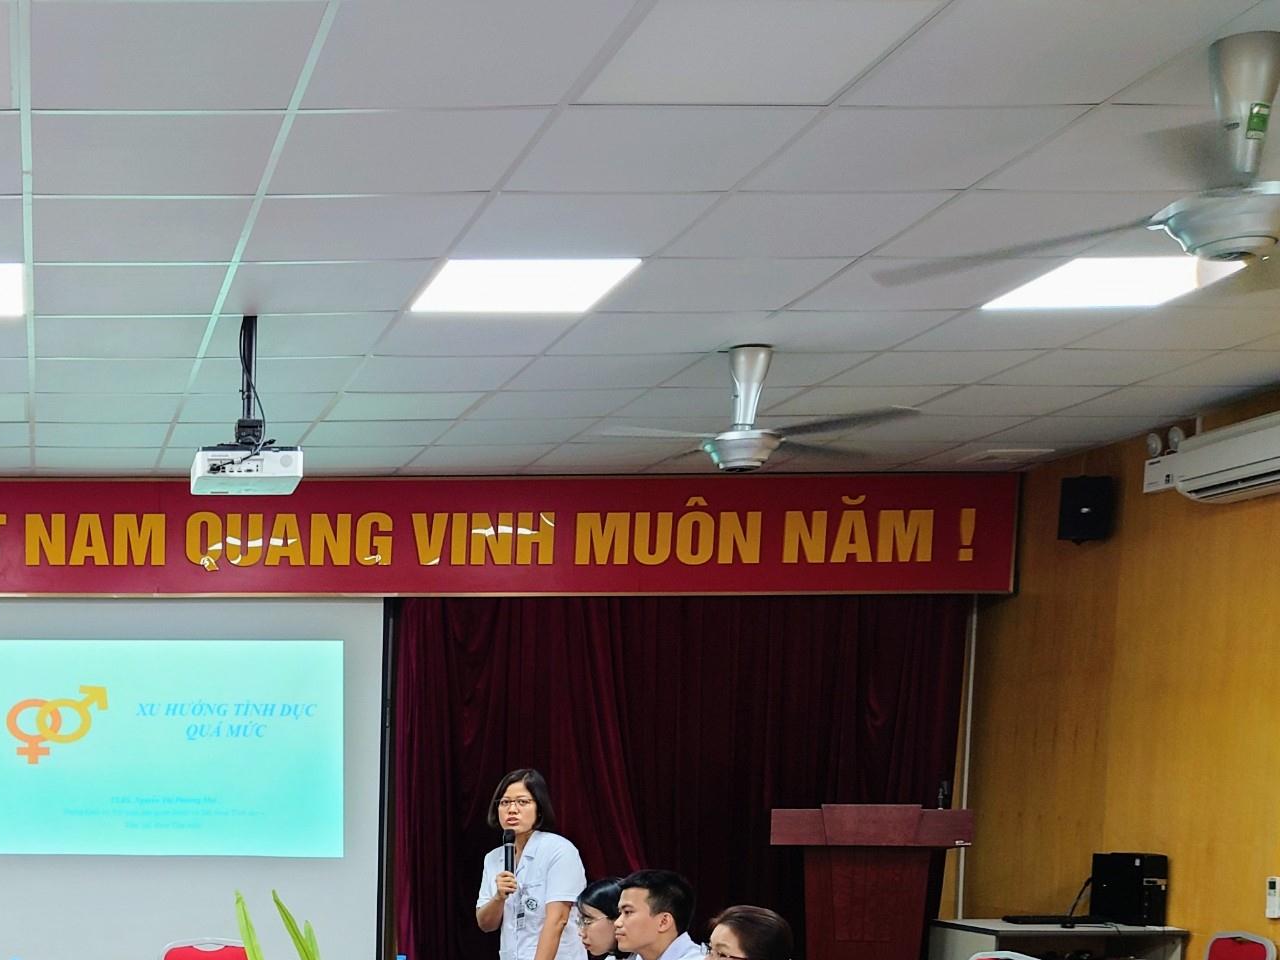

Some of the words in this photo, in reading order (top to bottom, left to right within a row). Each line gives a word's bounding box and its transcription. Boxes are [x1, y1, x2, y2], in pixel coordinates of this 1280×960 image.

[25, 513, 166, 566] NAM
[185, 511, 393, 572] QUANG
[412, 512, 555, 566] VINH
[573, 496, 762, 566] MUÔN
[781, 495, 935, 564] NĂM
[958, 508, 977, 562] !
[280, 703, 318, 720] DỤC
